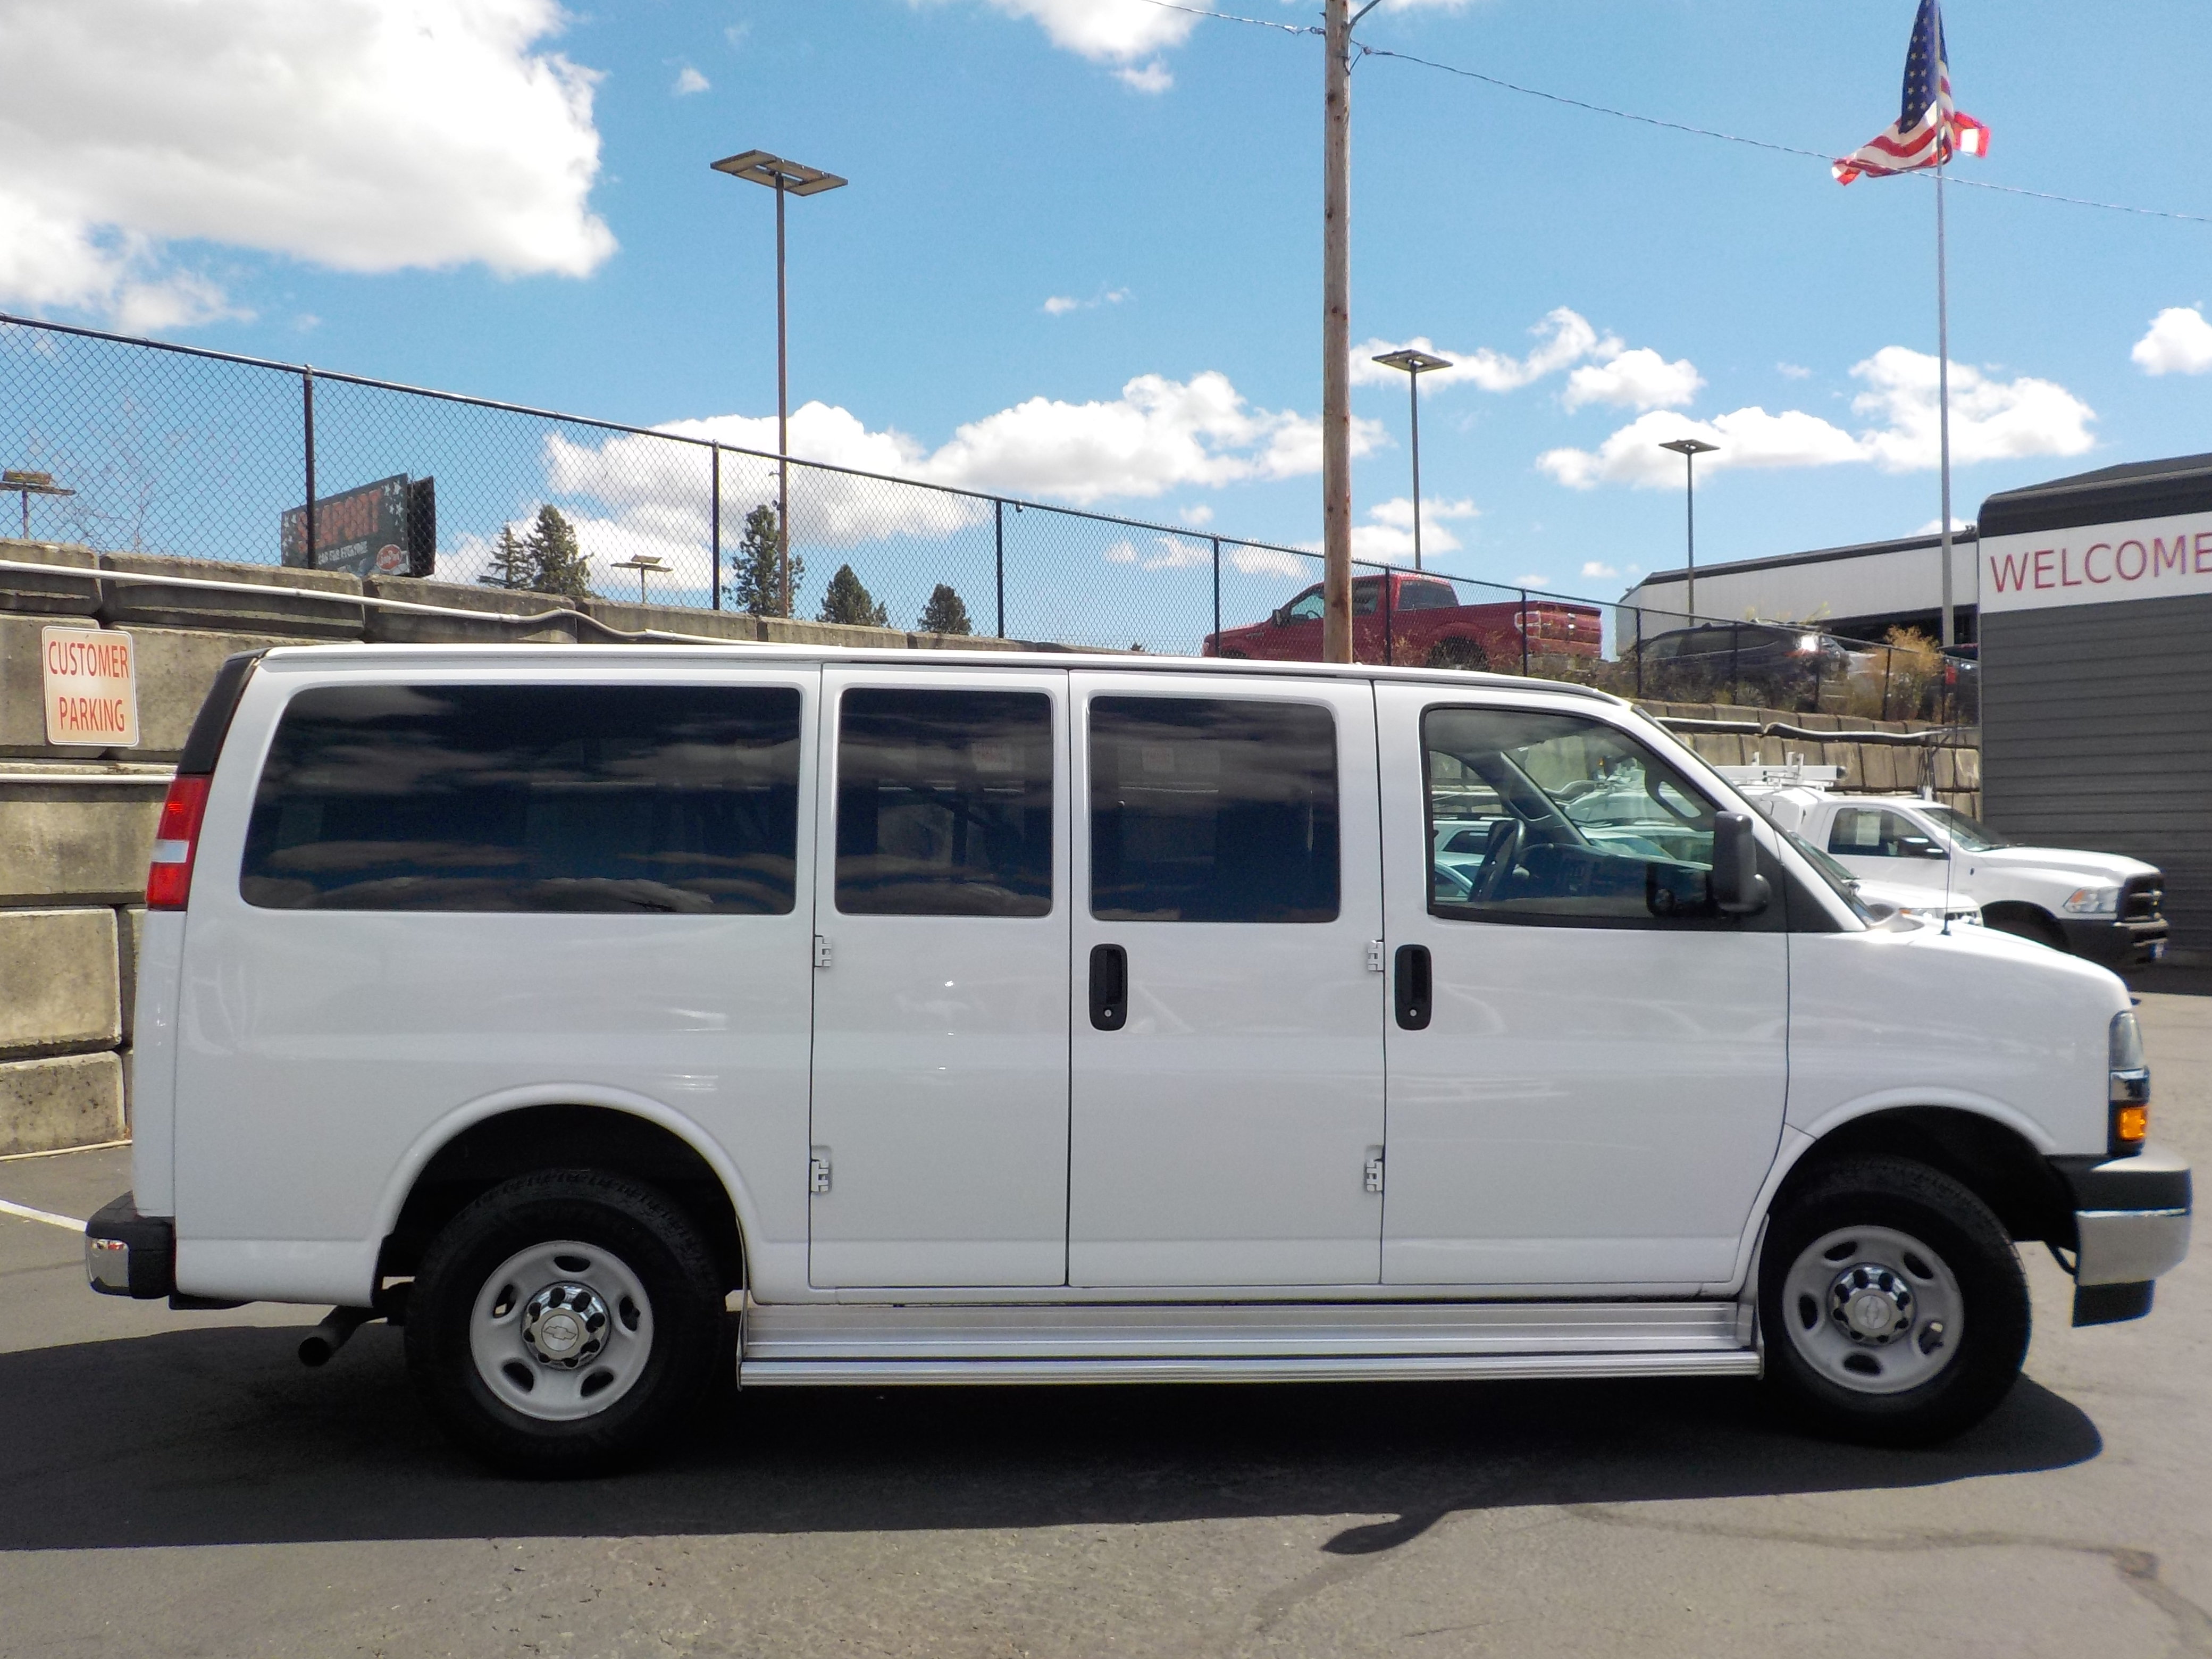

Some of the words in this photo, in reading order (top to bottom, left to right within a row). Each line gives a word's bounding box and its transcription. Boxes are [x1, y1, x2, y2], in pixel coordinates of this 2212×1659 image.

[1990, 532, 2212, 593] WELCOME
[48, 641, 129, 678] CUSTOMER
[59, 697, 125, 732] PARKING
